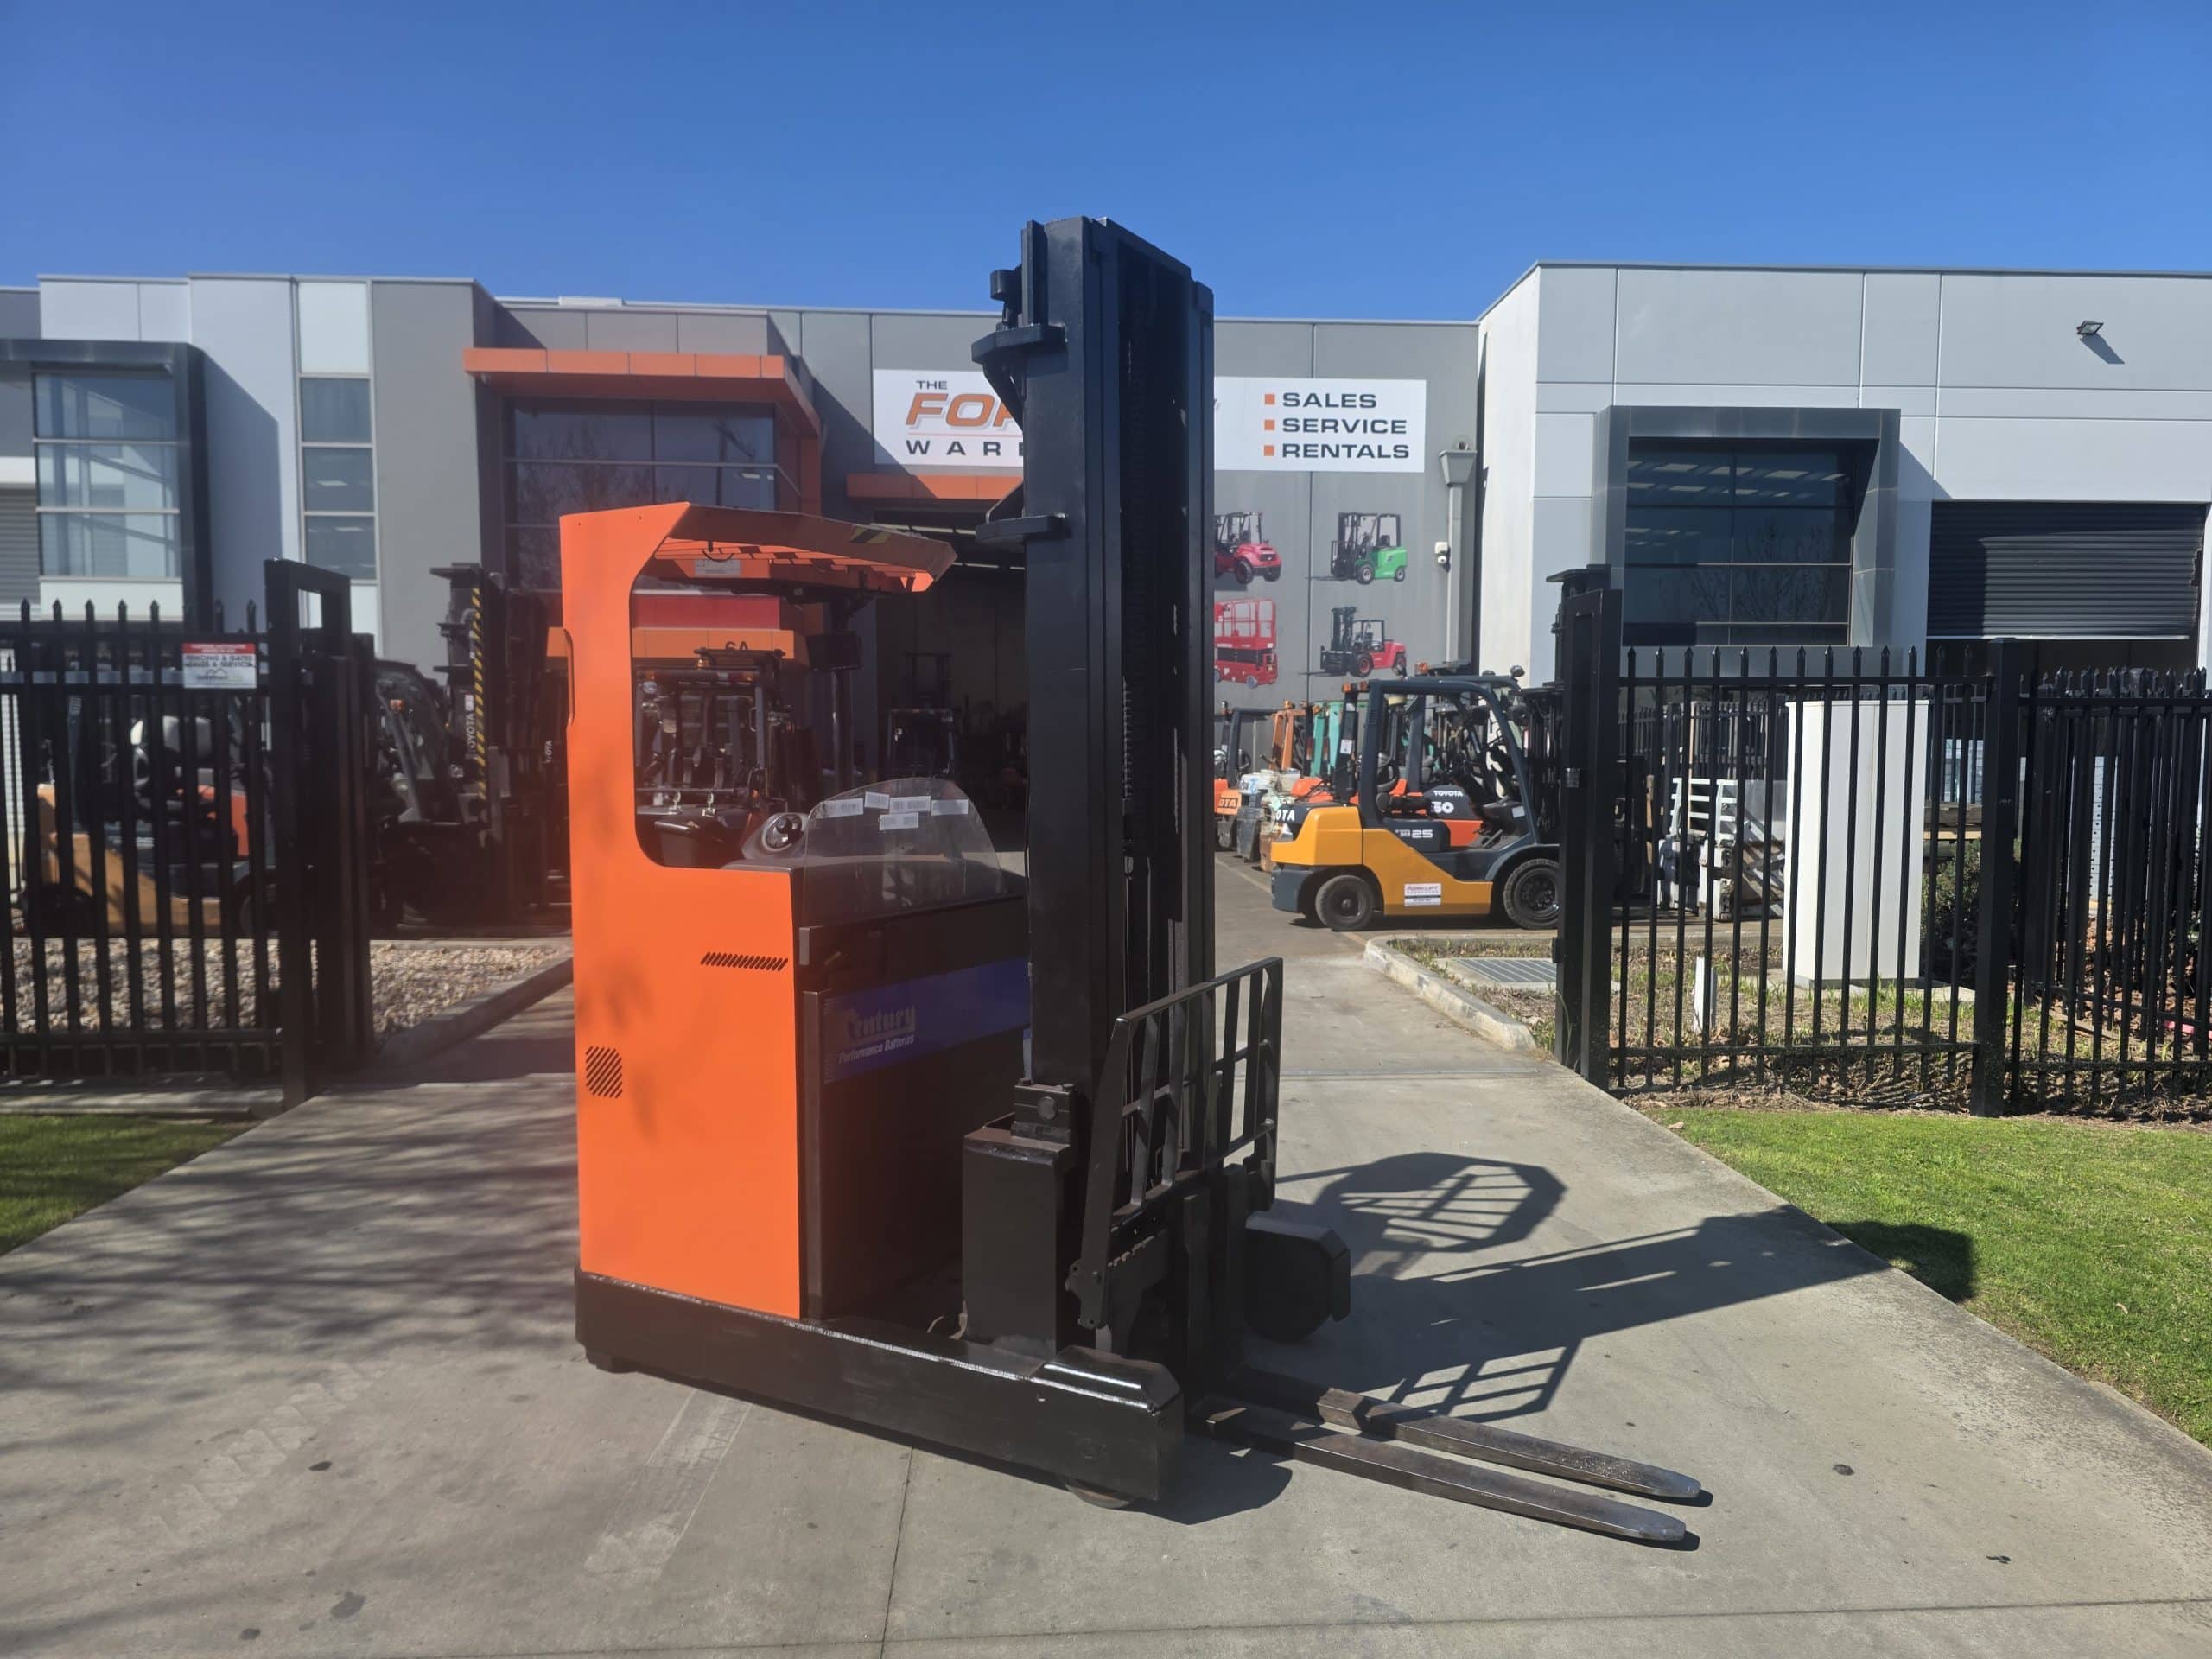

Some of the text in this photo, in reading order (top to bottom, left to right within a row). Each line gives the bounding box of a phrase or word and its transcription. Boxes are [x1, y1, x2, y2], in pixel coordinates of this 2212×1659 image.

[916, 380, 947, 390] THE
[1282, 392, 1377, 408] SALES
[1282, 418, 1408, 434] SERVICE
[1282, 443, 1410, 459] RENTALS
[1412, 830, 1433, 838] 25
